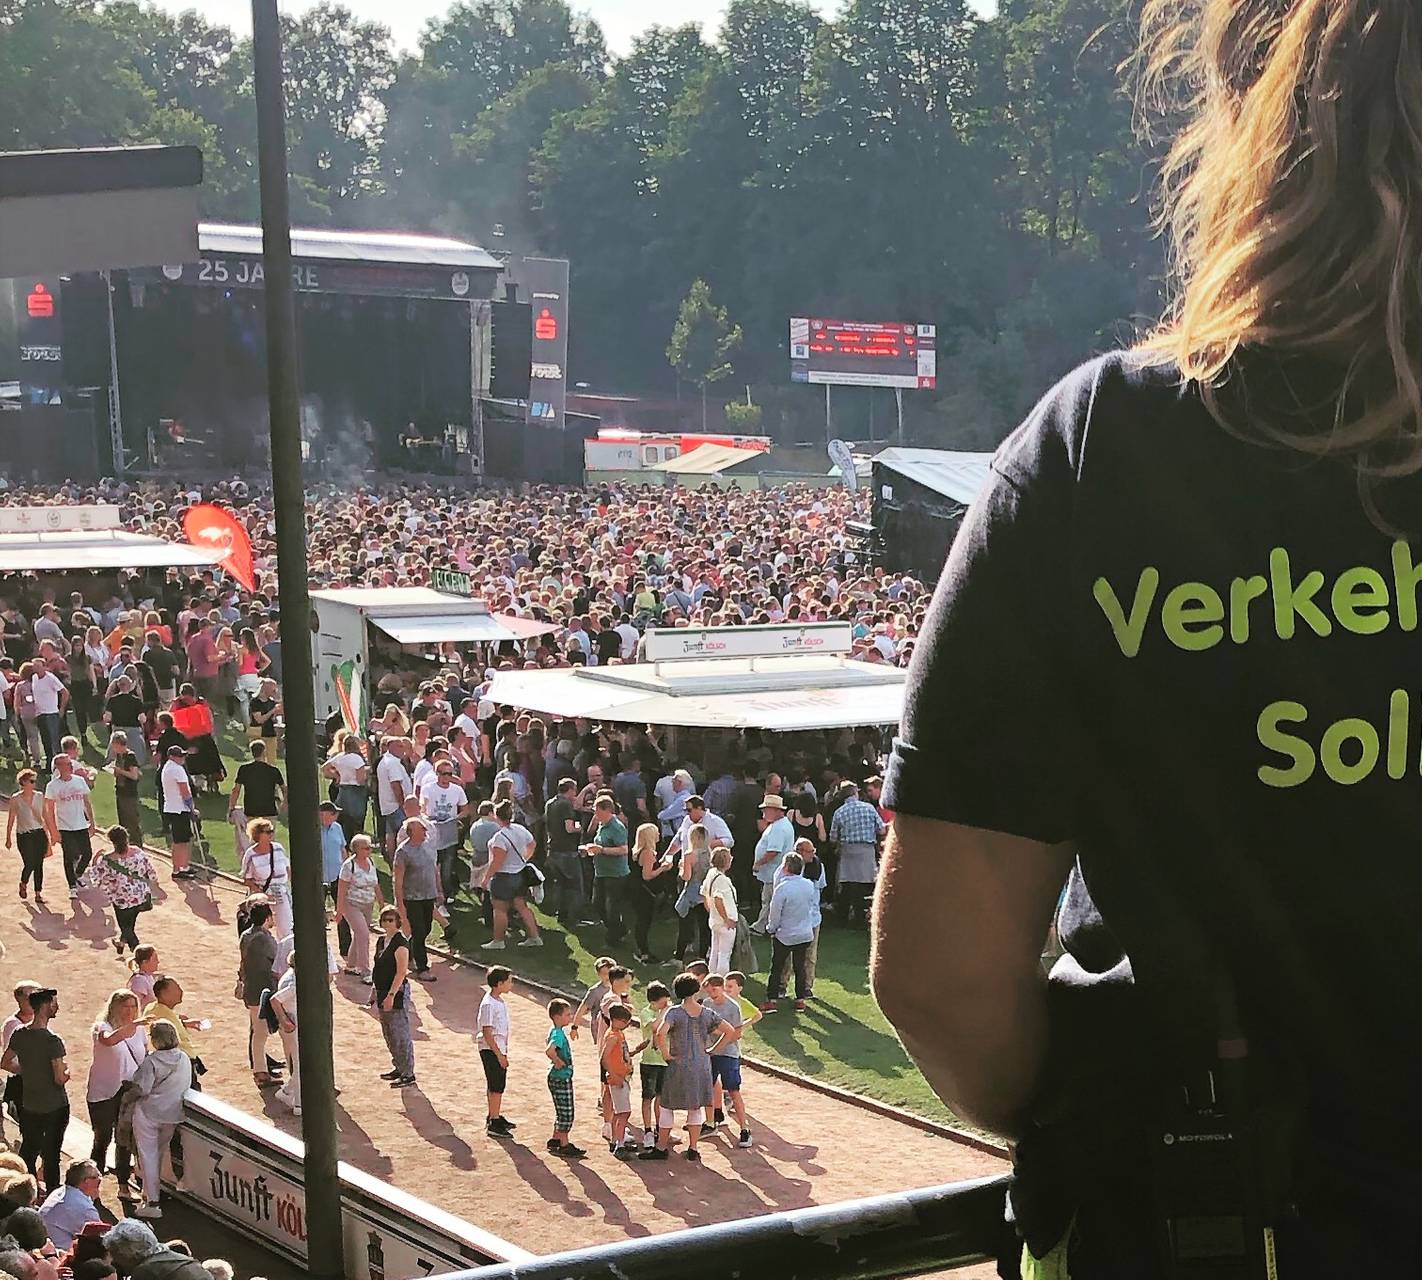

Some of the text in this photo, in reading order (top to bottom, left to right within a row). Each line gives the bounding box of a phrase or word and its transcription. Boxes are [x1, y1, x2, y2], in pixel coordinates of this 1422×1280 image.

[199, 260, 319, 288] 25 JARE
[1178, 1132, 1233, 1143] MOTOROLA
[209, 1150, 308, 1242] Zunft KÖL
